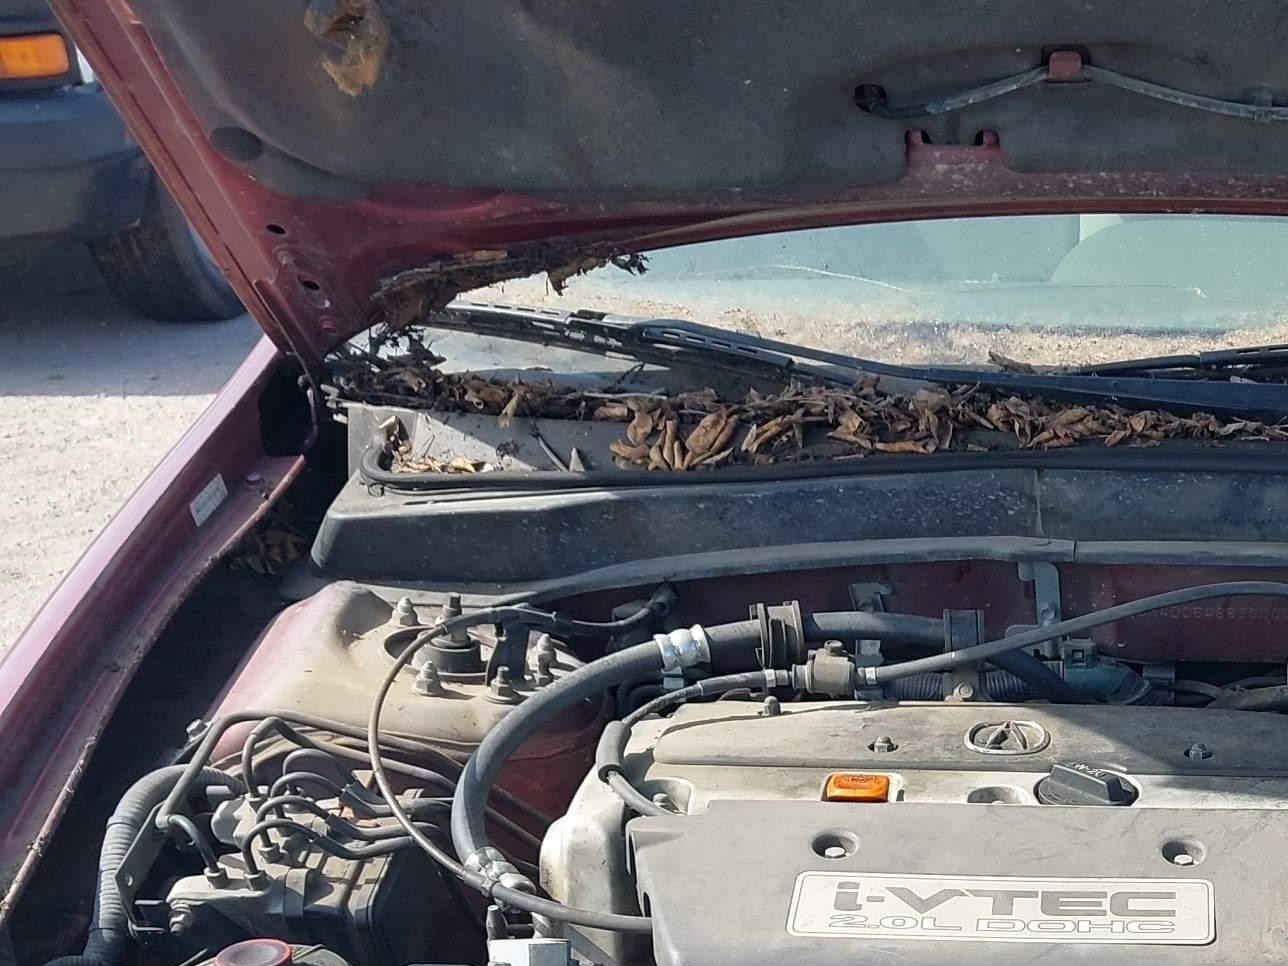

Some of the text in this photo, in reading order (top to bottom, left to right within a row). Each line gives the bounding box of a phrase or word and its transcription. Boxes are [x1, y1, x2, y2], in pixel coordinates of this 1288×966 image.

[833, 881, 1177, 918] i-VTEC
[828, 914, 1176, 934] 2.0L DOHC
